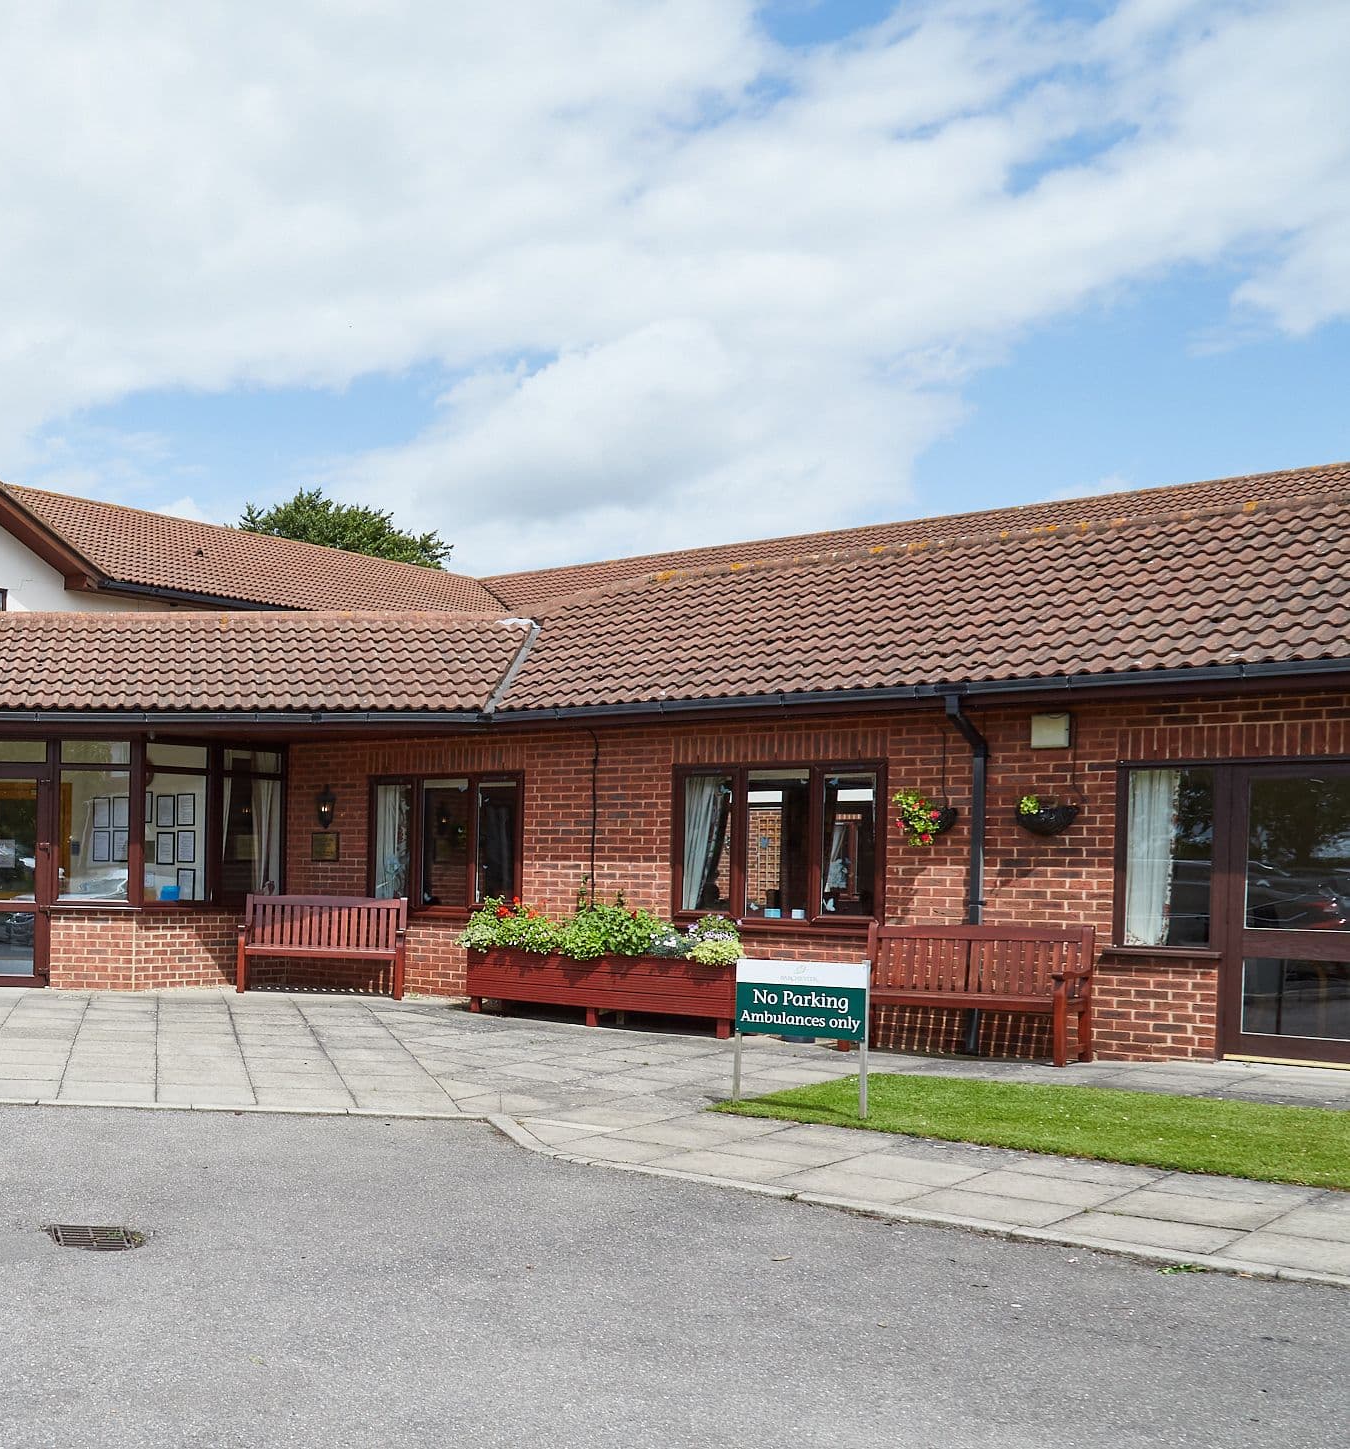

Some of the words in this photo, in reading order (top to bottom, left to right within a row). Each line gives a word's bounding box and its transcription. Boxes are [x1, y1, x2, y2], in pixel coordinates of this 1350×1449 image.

[752, 988, 779, 1005] No
[782, 990, 849, 1014] Parking
[740, 1009, 826, 1028] Ambulances
[828, 1015, 861, 1034] only
